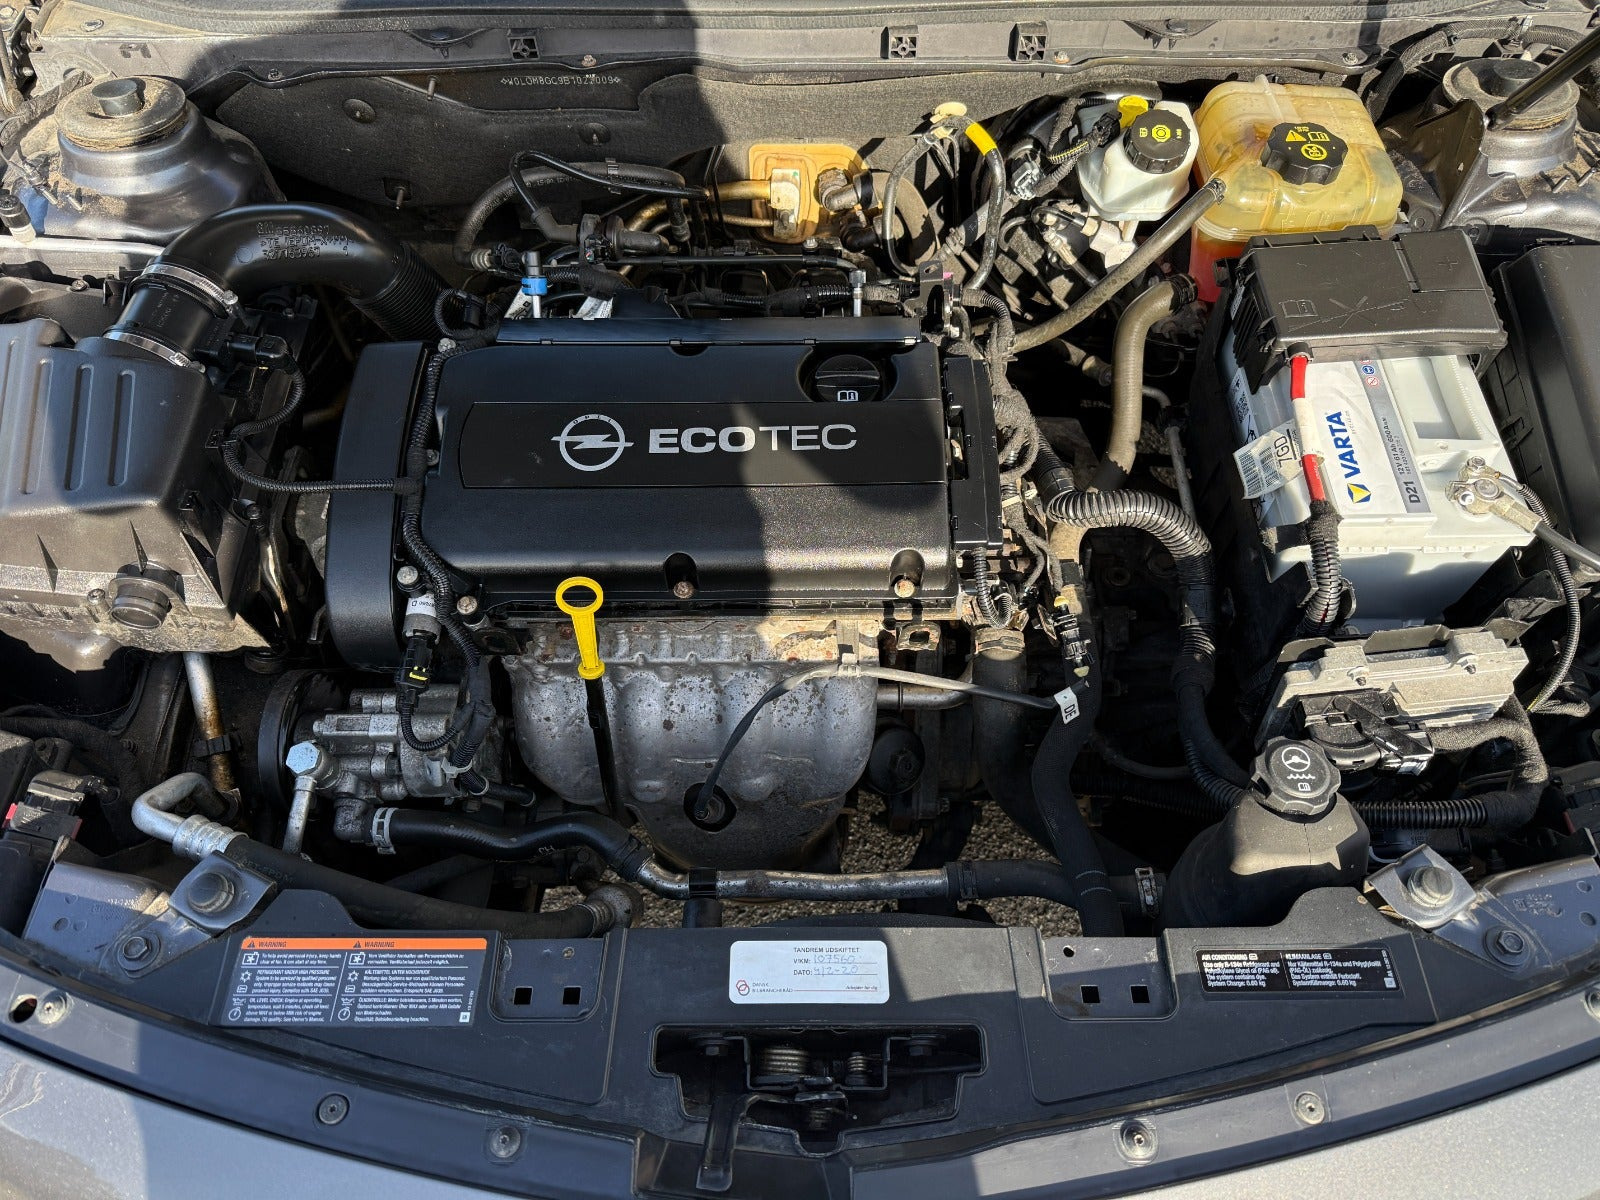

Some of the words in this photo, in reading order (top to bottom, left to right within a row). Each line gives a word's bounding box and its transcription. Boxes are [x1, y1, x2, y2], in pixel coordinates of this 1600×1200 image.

[648, 424, 857, 454] ECOTEC
[1326, 411, 1361, 478] VARTA
[1403, 480, 1420, 504] D21
